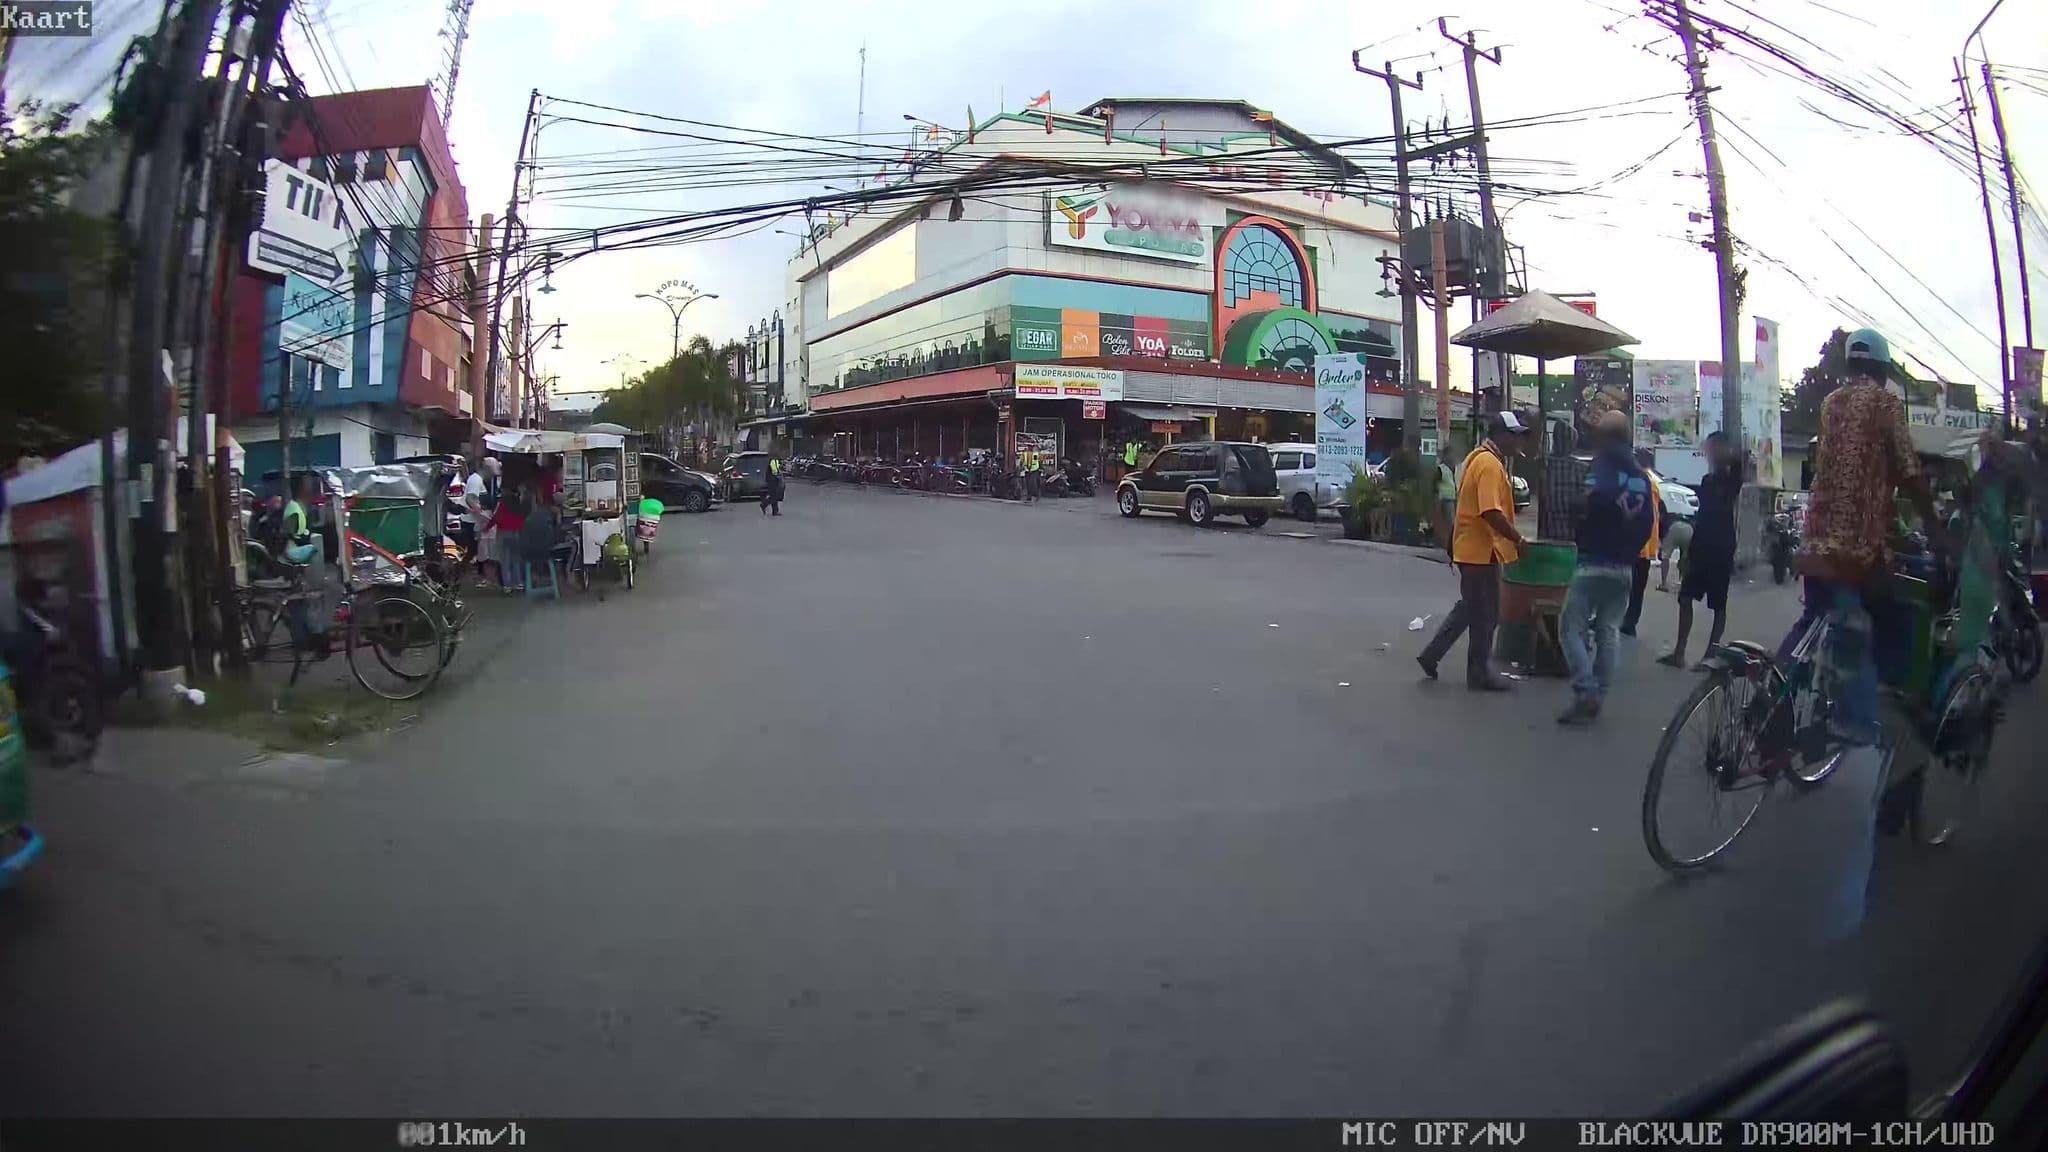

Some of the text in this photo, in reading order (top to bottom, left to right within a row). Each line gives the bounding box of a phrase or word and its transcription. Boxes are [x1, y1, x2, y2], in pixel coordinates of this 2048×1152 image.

[656, 279, 699, 295] KOPO MAS
[1041, 369, 1095, 379] OPERASIONAL
[1097, 372, 1117, 380] TOKO
[1318, 368, 1355, 387] Order
[1635, 393, 1669, 403] DISKON
